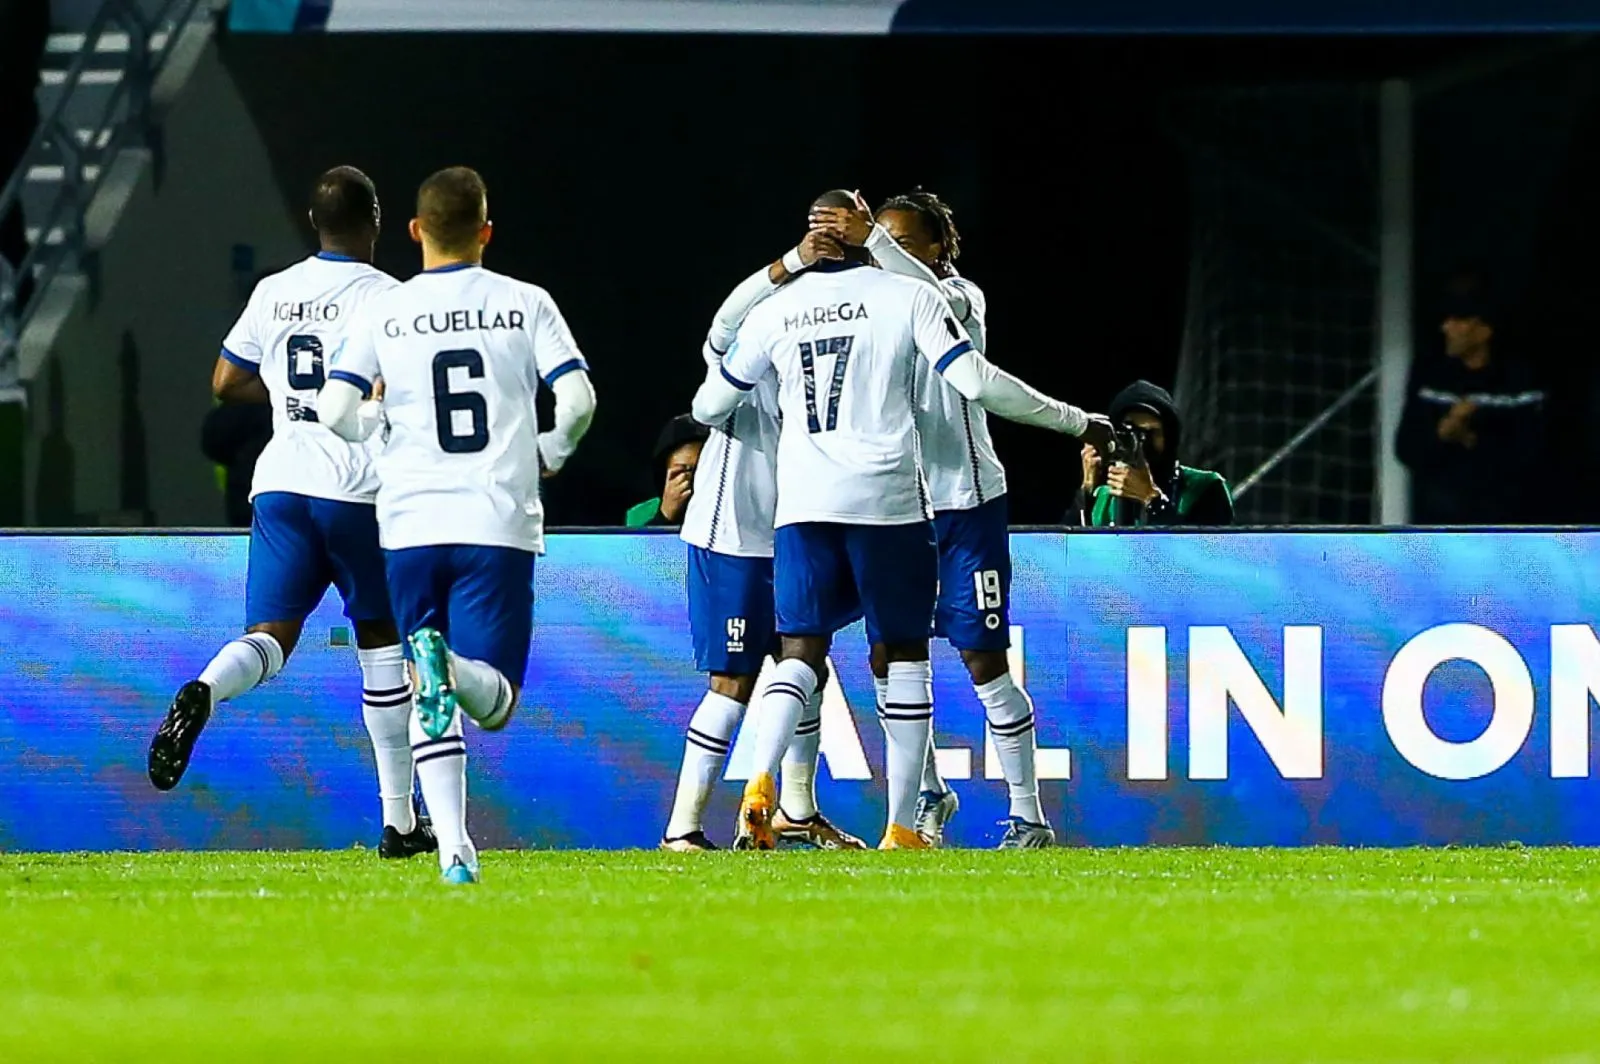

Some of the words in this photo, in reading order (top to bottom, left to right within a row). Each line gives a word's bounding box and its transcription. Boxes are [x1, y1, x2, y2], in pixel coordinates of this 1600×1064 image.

[384, 317, 407, 338] G.
[413, 309, 525, 334] CUELLAR
[784, 303, 868, 333] MAREGA
[432, 348, 490, 454] 6
[798, 335, 855, 434] 17
[974, 570, 1001, 610] 19
[1127, 625, 1323, 780] IN
